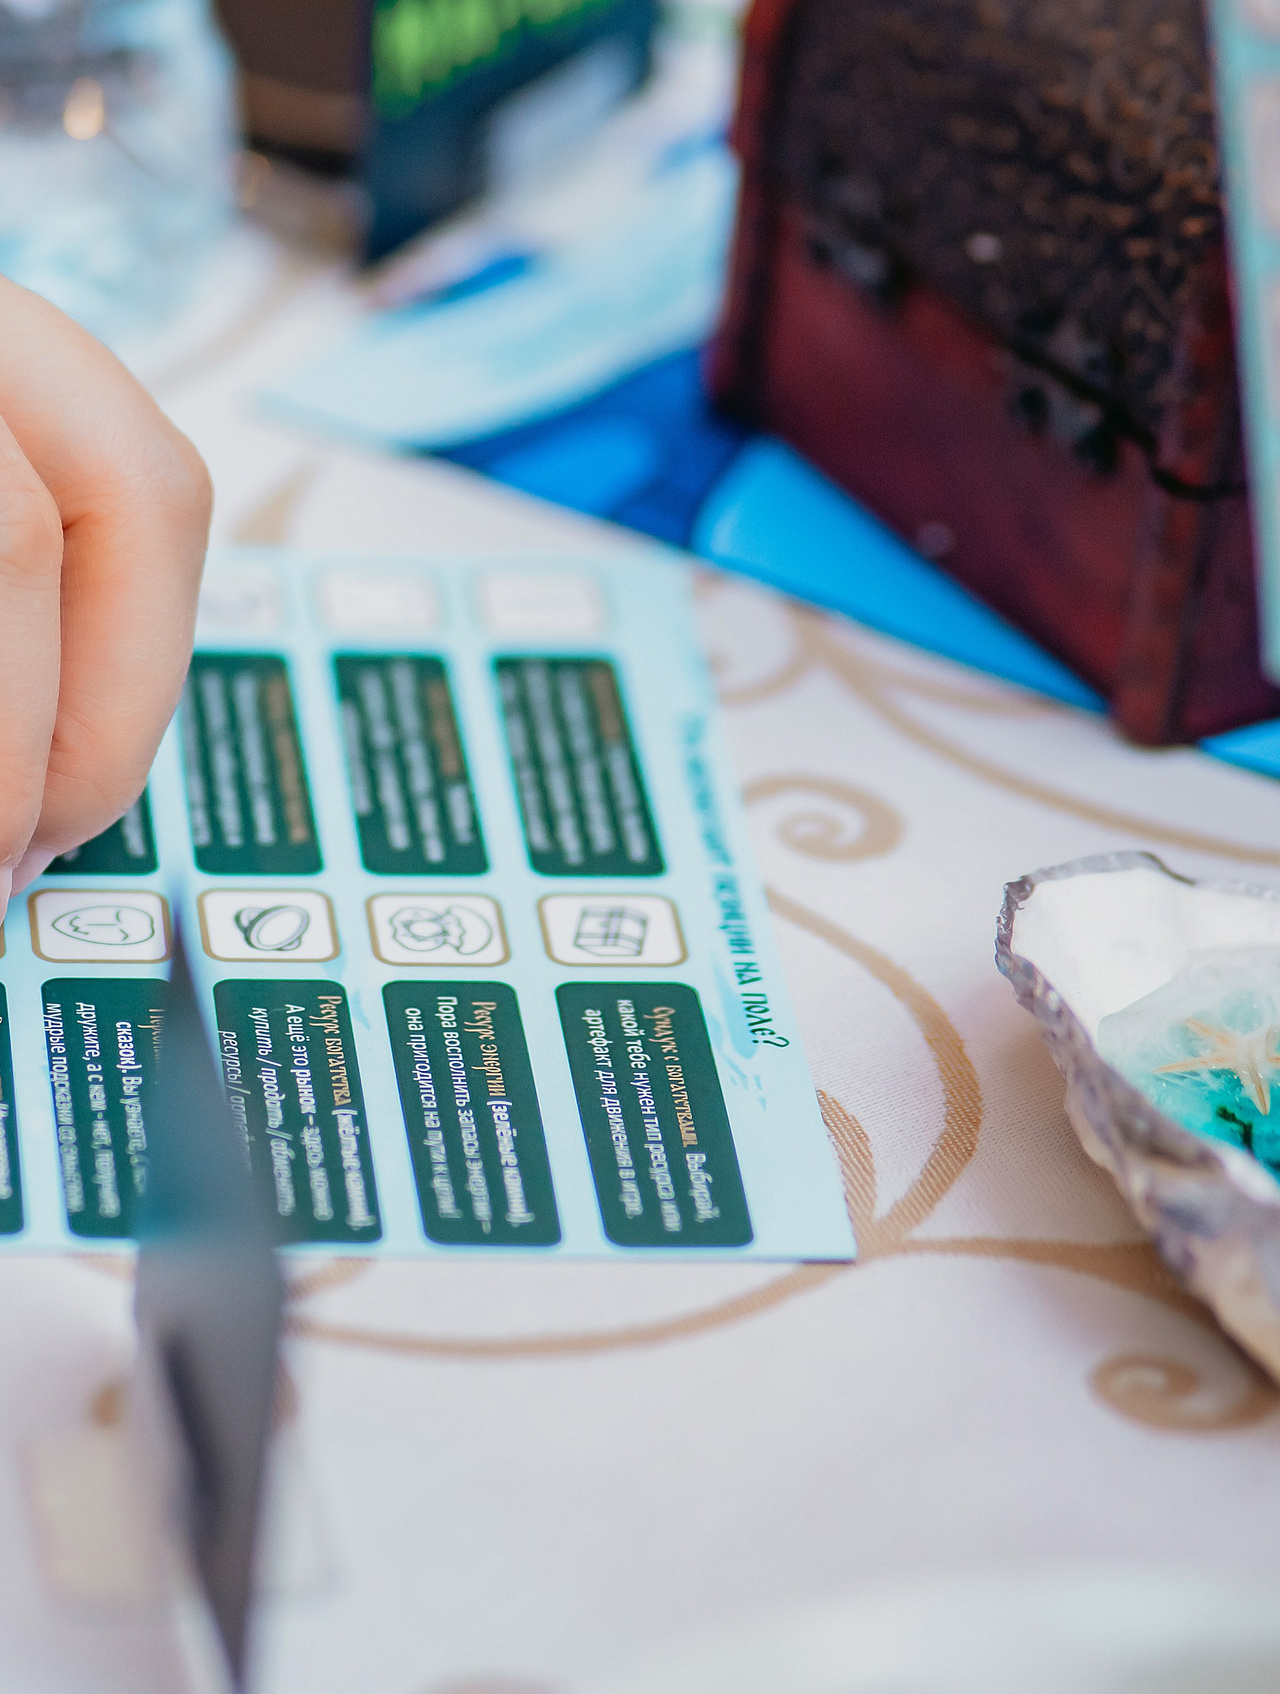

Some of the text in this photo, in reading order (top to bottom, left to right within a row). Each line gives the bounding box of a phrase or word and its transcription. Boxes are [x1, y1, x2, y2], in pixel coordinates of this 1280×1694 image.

[733, 961, 763, 985] на
[42, 1003, 65, 1053] мудрые
[75, 1002, 102, 1061] дружите,
[248, 1007, 275, 1056] купить
[284, 1004, 305, 1013] А
[285, 1016, 308, 1042] ещё
[308, 995, 342, 1034] Ресурс
[405, 1008, 425, 1031] она
[435, 996, 459, 1028] Пора
[463, 1001, 497, 1040] Ресурс
[617, 1000, 645, 1037] какой
[741, 993, 790, 1048] поле?
[116, 1021, 142, 1073] сказок).
[218, 1031, 243, 1083] ресурсы
[290, 1045, 310, 1066] это
[581, 1009, 612, 1067] артефакт
[626, 1040, 651, 1069] тебе
[48, 1057, 75, 1125] подсказки
[87, 1074, 103, 1082] с
[122, 1076, 143, 1096] Вы
[290, 1069, 317, 1114] рынок
[323, 1038, 352, 1106] богатства
[406, 1034, 438, 1108] пригодится
[443, 1032, 471, 1106] восполнить
[471, 1044, 507, 1096] энергии
[595, 1070, 618, 1095] для
[630, 1072, 657, 1114] нужен
[257, 1067, 286, 1128] продать
[424, 1111, 440, 1128] на
[643, 1006, 676, 1053] Сундук
[685, 1153, 721, 1223] Выбирай,
[300, 1126, 323, 1167] здесь
[332, 1109, 360, 1170] (жёлтые
[457, 1109, 480, 1158] запасы
[487, 1100, 517, 1166] (зелёные
[600, 1097, 633, 1167] движения
[643, 1117, 663, 1141] тип
[644, 1143, 675, 1199] ресурса
